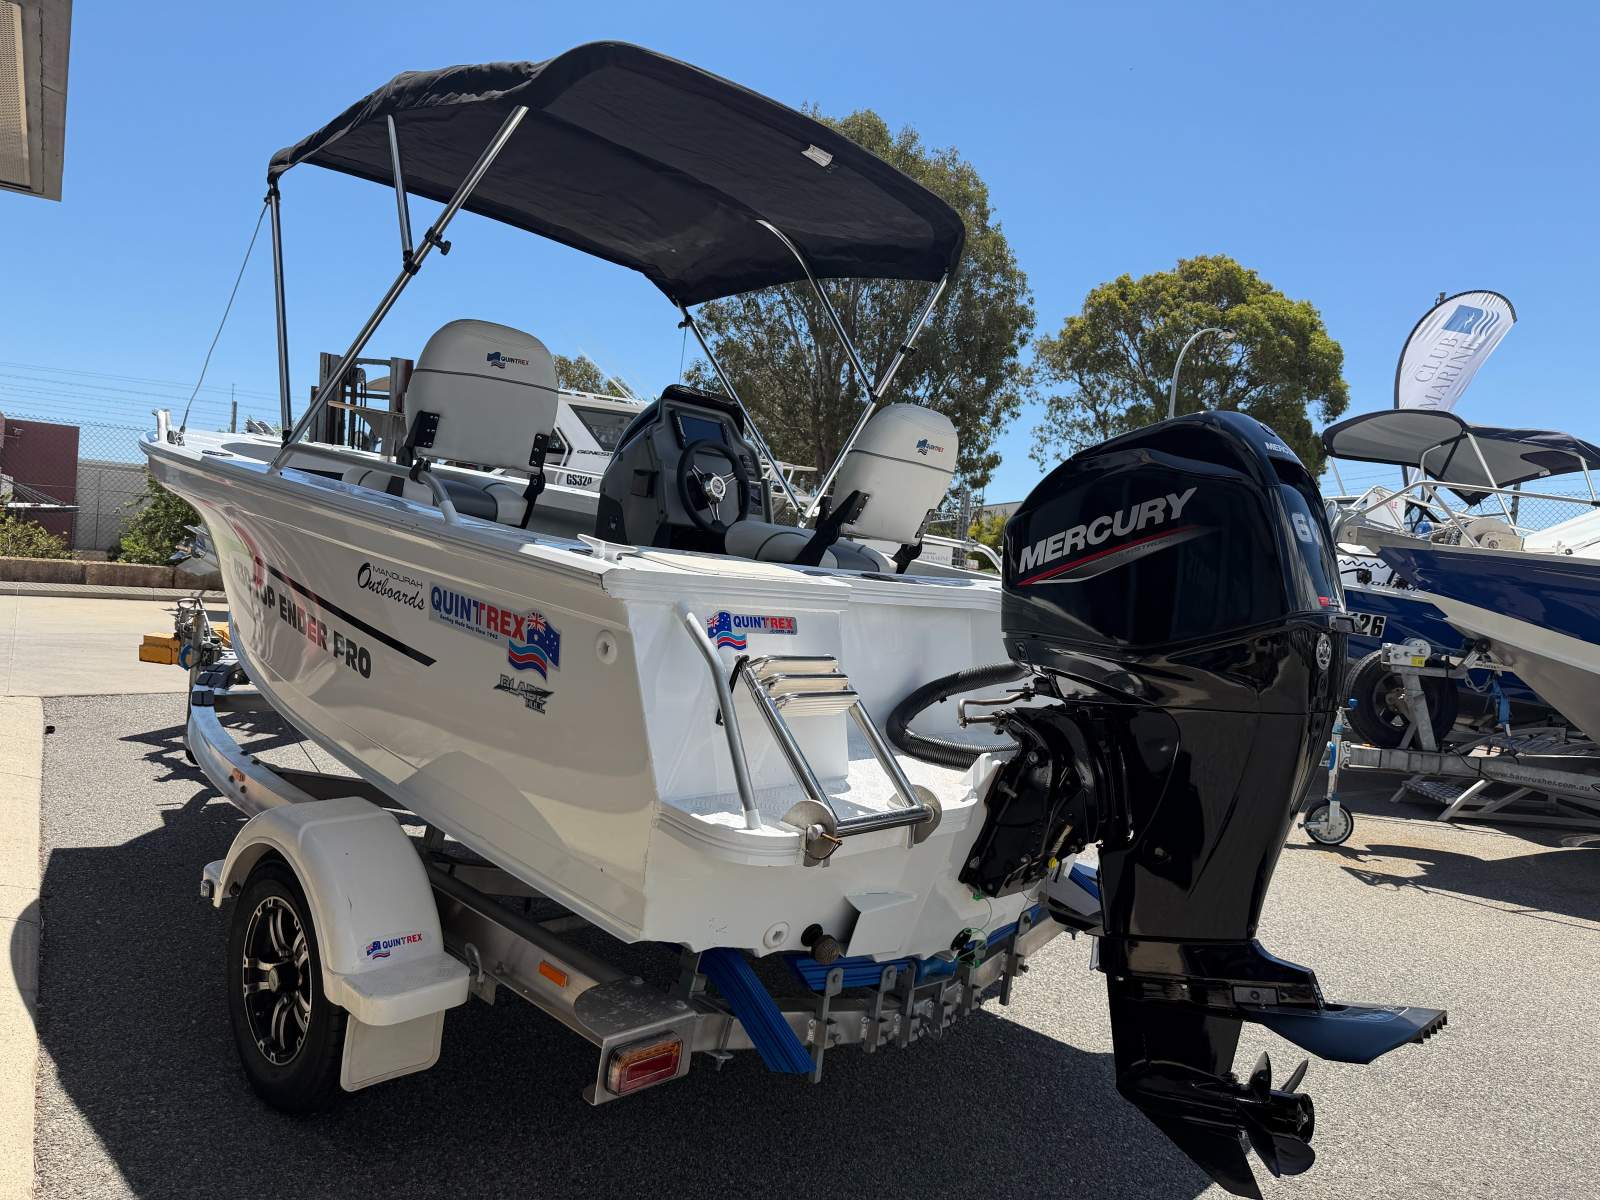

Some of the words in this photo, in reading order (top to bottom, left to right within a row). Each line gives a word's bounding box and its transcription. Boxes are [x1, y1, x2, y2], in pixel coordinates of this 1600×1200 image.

[501, 356, 529, 366] QUINTREX
[1415, 337, 1459, 383] CLUB
[576, 449, 613, 457] GENESI
[1018, 486, 1198, 574] MERCURY
[357, 562, 425, 610] Outboards
[372, 564, 423, 590] MANDURAH
[431, 586, 526, 642] QUINTREX
[732, 615, 794, 629] QUINTREX
[278, 593, 329, 652] ENDER
[333, 630, 372, 679] PRO
[382, 934, 423, 949] QUINTREX
